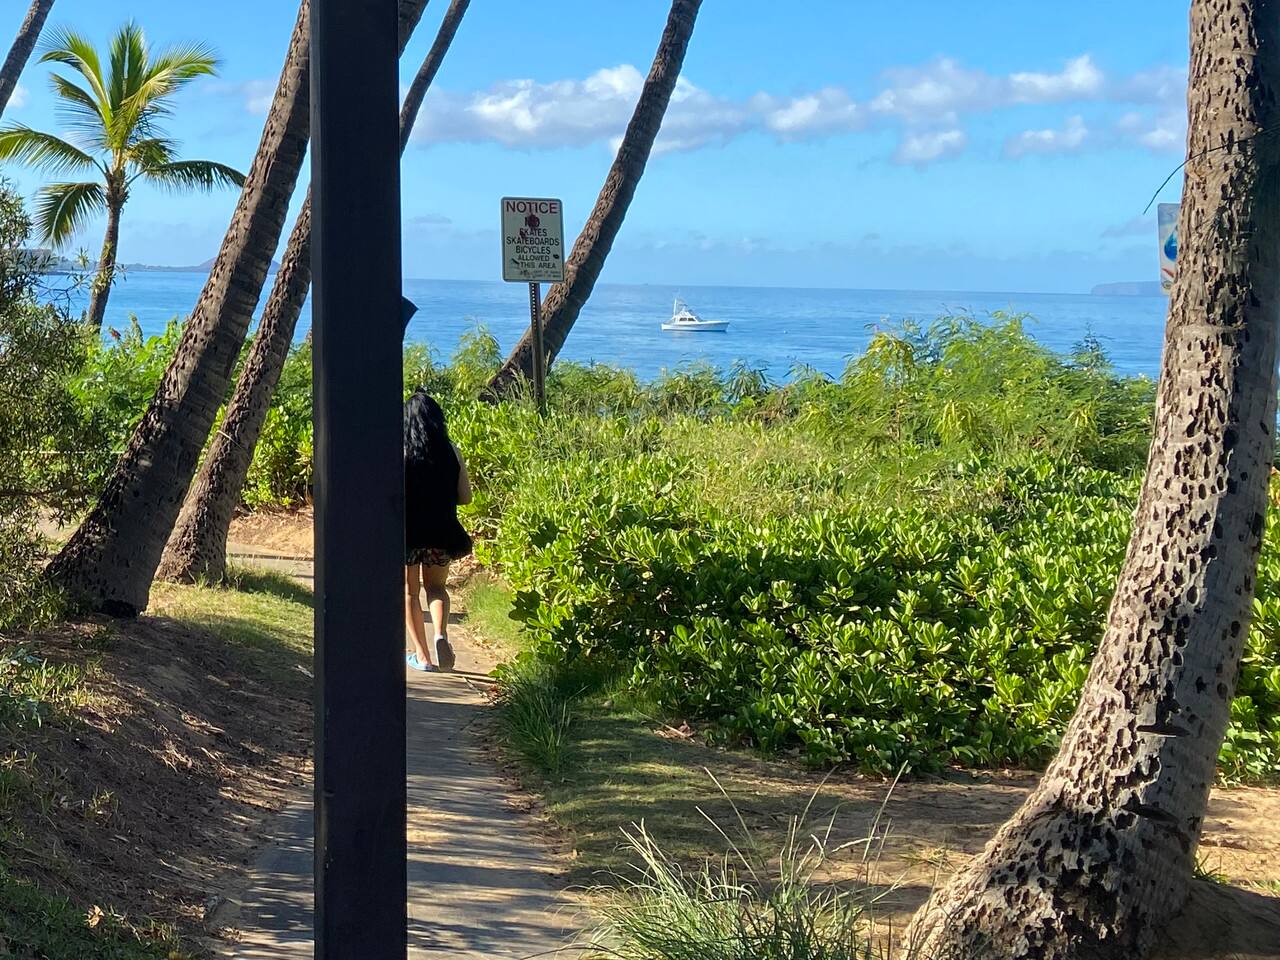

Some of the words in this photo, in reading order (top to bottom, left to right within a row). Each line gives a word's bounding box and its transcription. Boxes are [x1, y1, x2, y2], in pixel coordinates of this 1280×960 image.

[506, 201, 558, 214] NOTICE
[519, 228, 548, 237] SKATES
[506, 236, 560, 246] SKATEBOARDS
[515, 245, 551, 255] BICYCLES
[518, 254, 550, 262] ALLOWED
[520, 261, 536, 269] THIS
